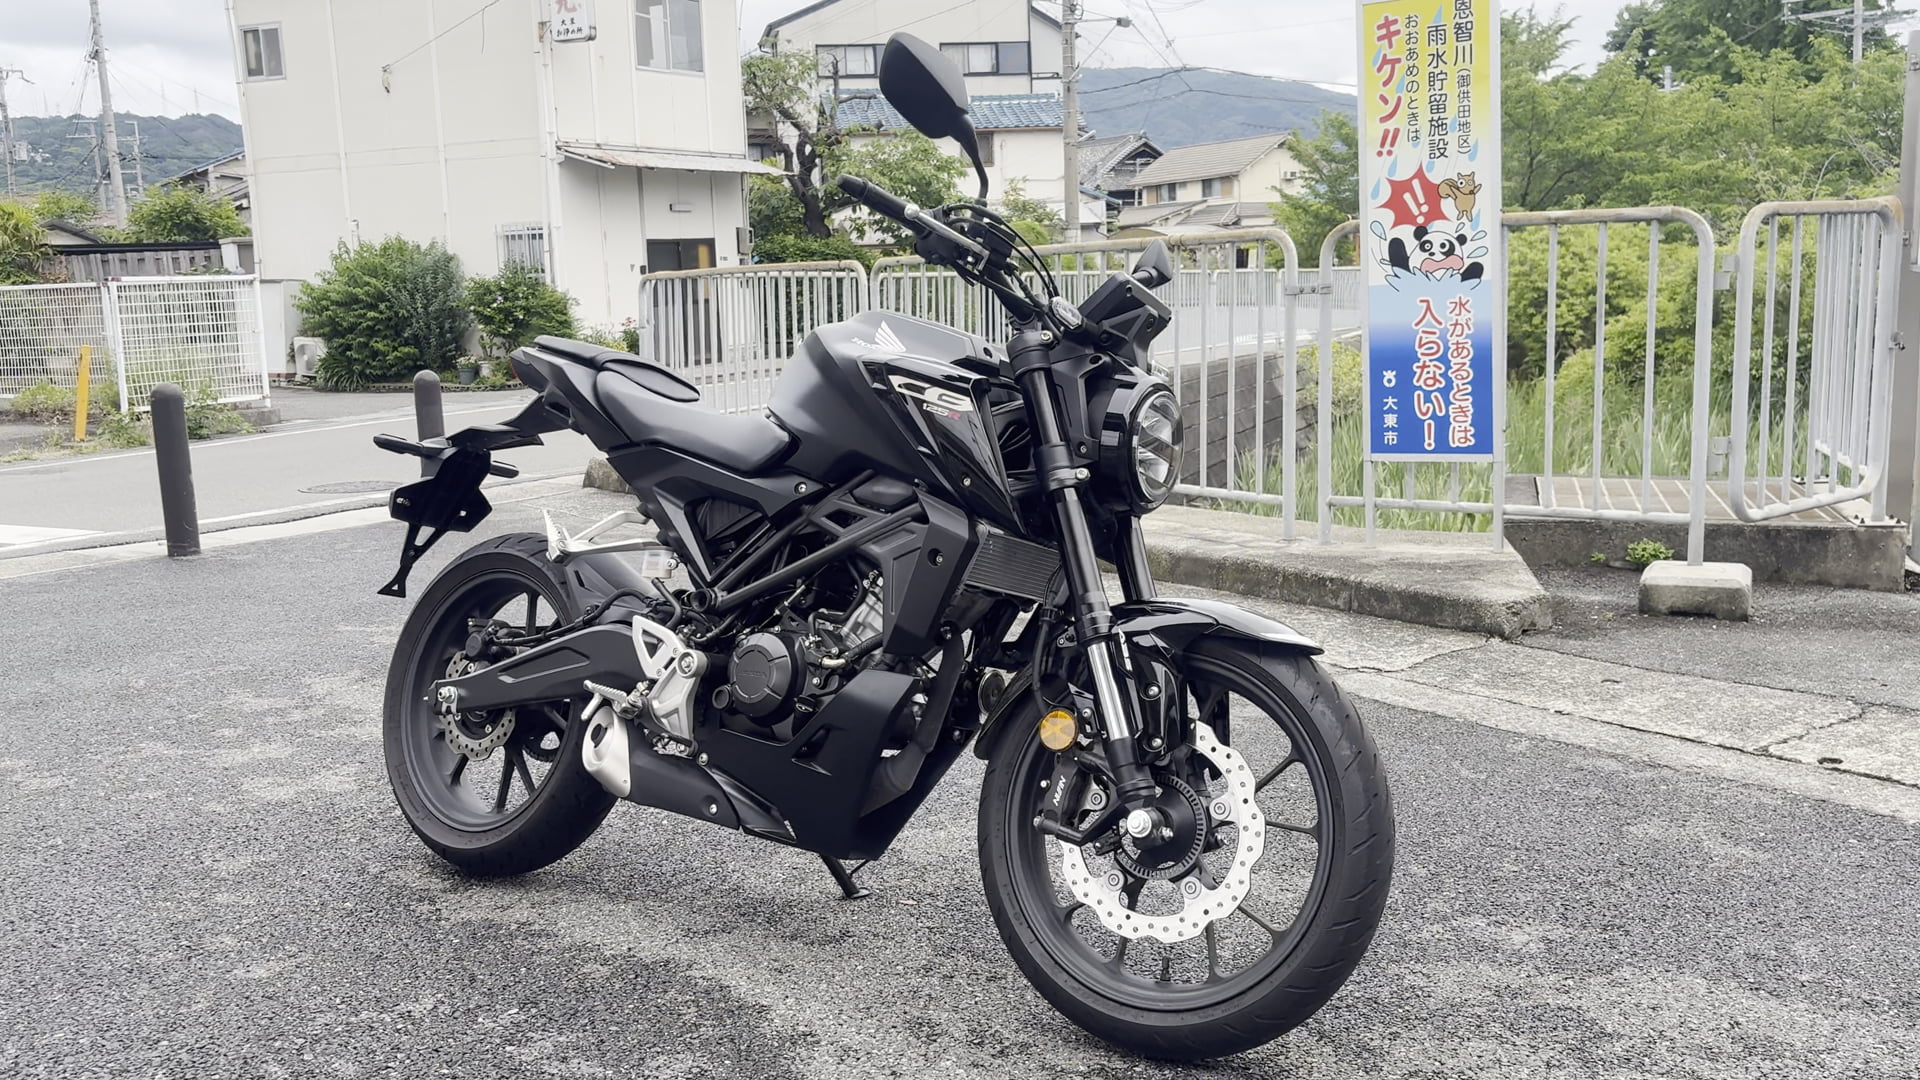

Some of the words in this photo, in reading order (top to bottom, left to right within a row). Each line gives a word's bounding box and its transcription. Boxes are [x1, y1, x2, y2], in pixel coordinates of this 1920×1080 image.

[1376, 15, 1402, 158] キケン!!
[1404, 14, 1421, 142] おおあめのときは
[1426, 24, 1449, 160] 雨水貯留施設
[922, 402, 961, 420] 125R
[1383, 396, 1398, 446] 大東市
[1413, 299, 1444, 449] 入らない!
[1449, 296, 1474, 447] 水があるときは
